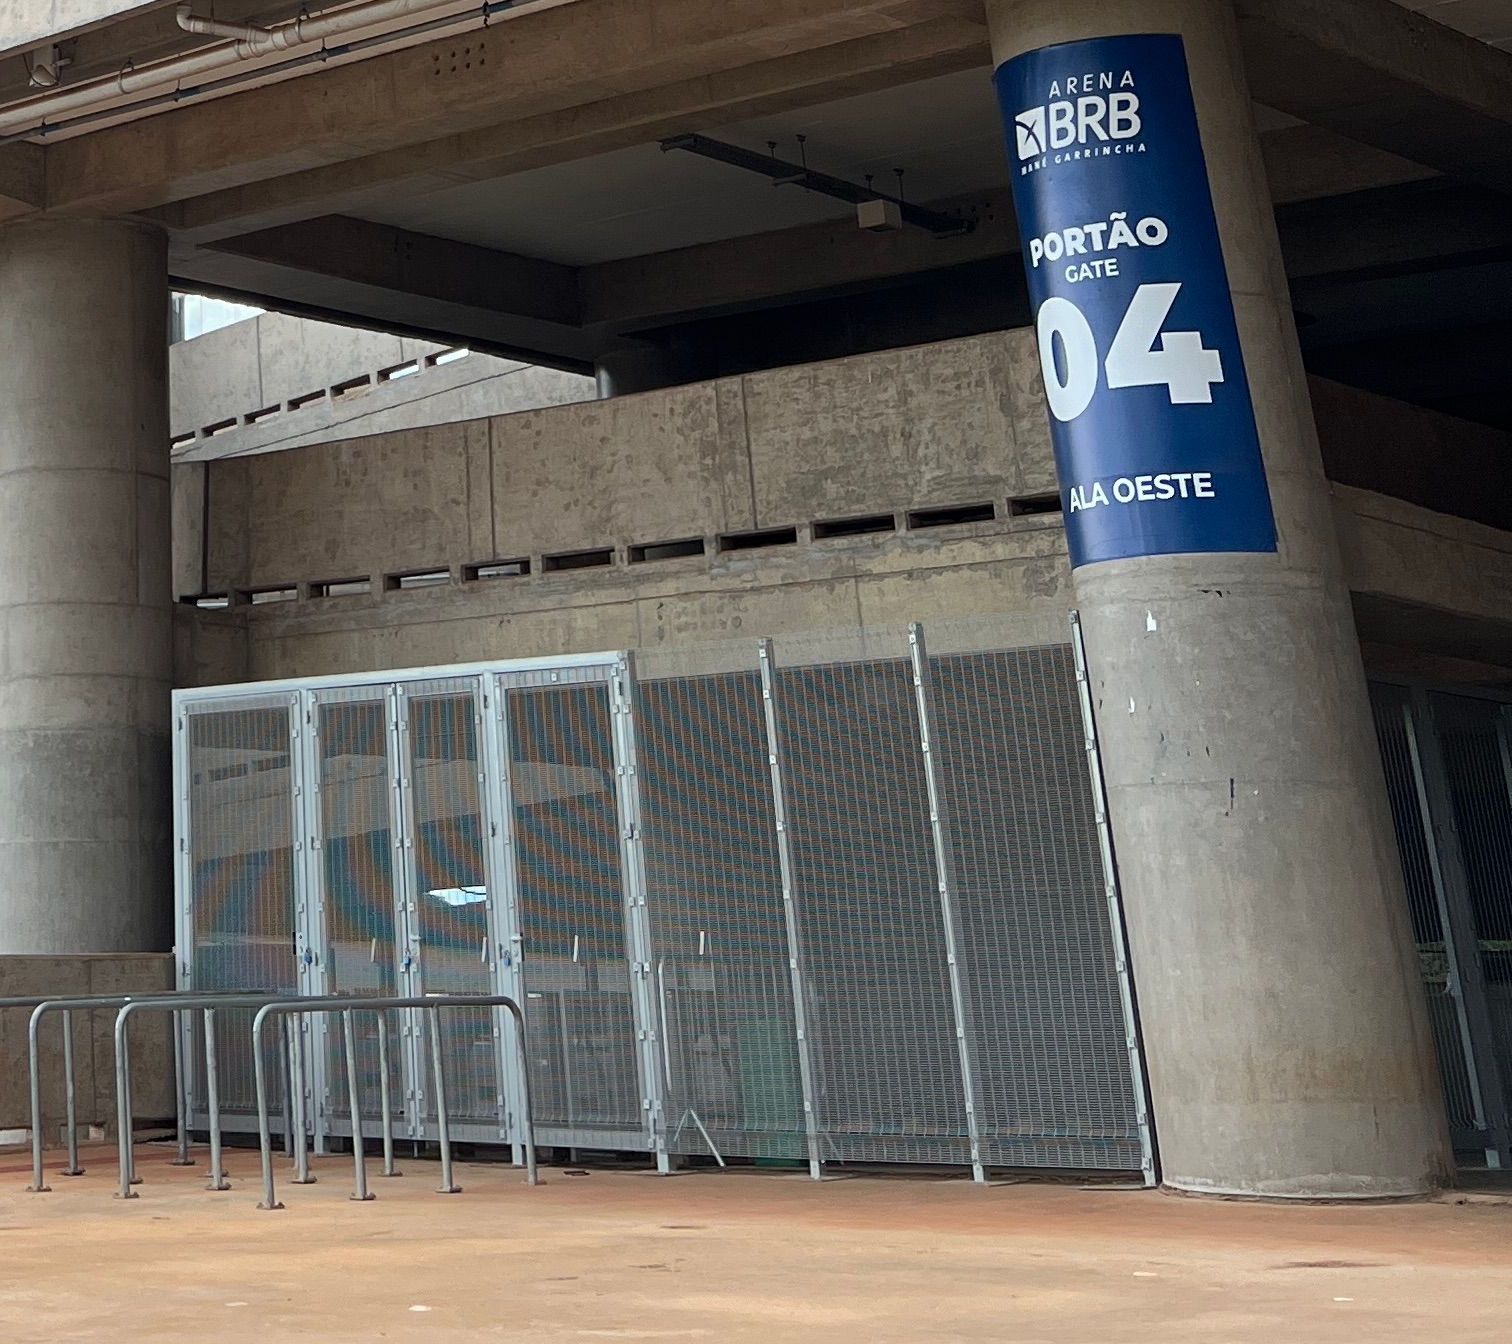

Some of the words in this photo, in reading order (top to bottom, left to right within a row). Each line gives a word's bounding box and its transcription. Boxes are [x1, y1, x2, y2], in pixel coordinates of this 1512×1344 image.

[1048, 70, 1135, 99] ARENA
[1048, 91, 1142, 150] BRB
[1054, 143, 1146, 164] GARRINCHA
[1029, 211, 1168, 268] PORTÃO
[1065, 258, 1120, 283] GATE
[1036, 281, 1225, 423] 04
[1070, 481, 1110, 513] ALA
[1112, 472, 1216, 504] OESTE
